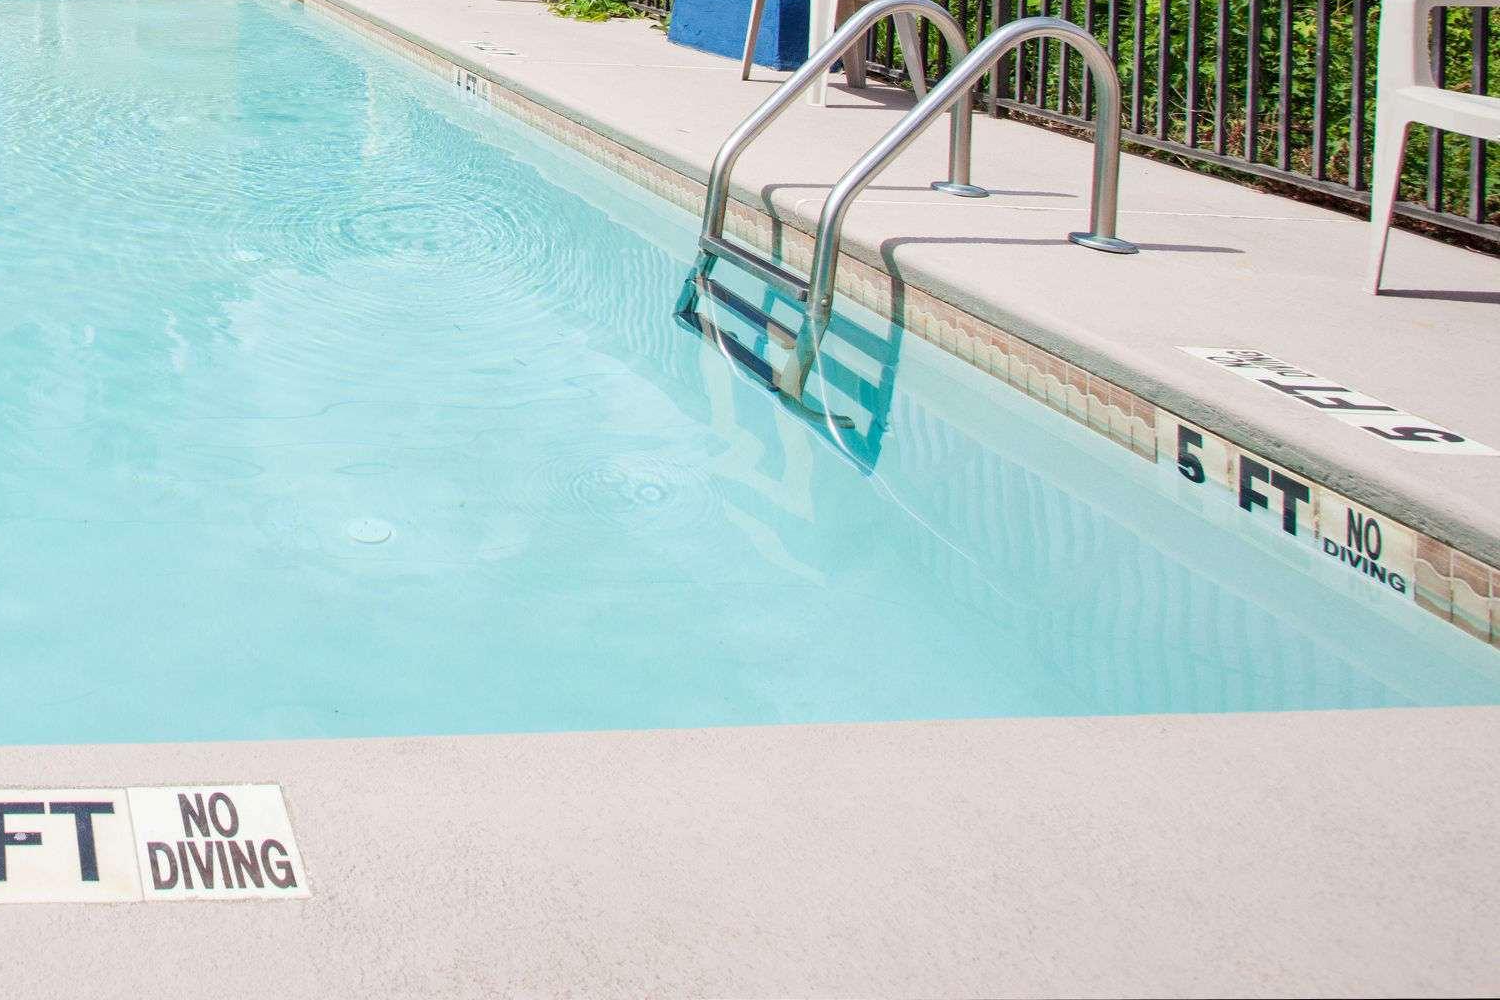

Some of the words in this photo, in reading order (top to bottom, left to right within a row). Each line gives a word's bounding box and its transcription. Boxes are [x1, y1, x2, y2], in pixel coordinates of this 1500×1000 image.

[1256, 378, 1397, 411] FT
[1360, 426, 1466, 444] 5
[1176, 424, 1206, 484] 5
[1238, 454, 1311, 536] FT
[1346, 507, 1382, 561] NO
[1322, 536, 1406, 594] DIVING
[177, 792, 239, 840] NO
[147, 838, 298, 890] DIVING
